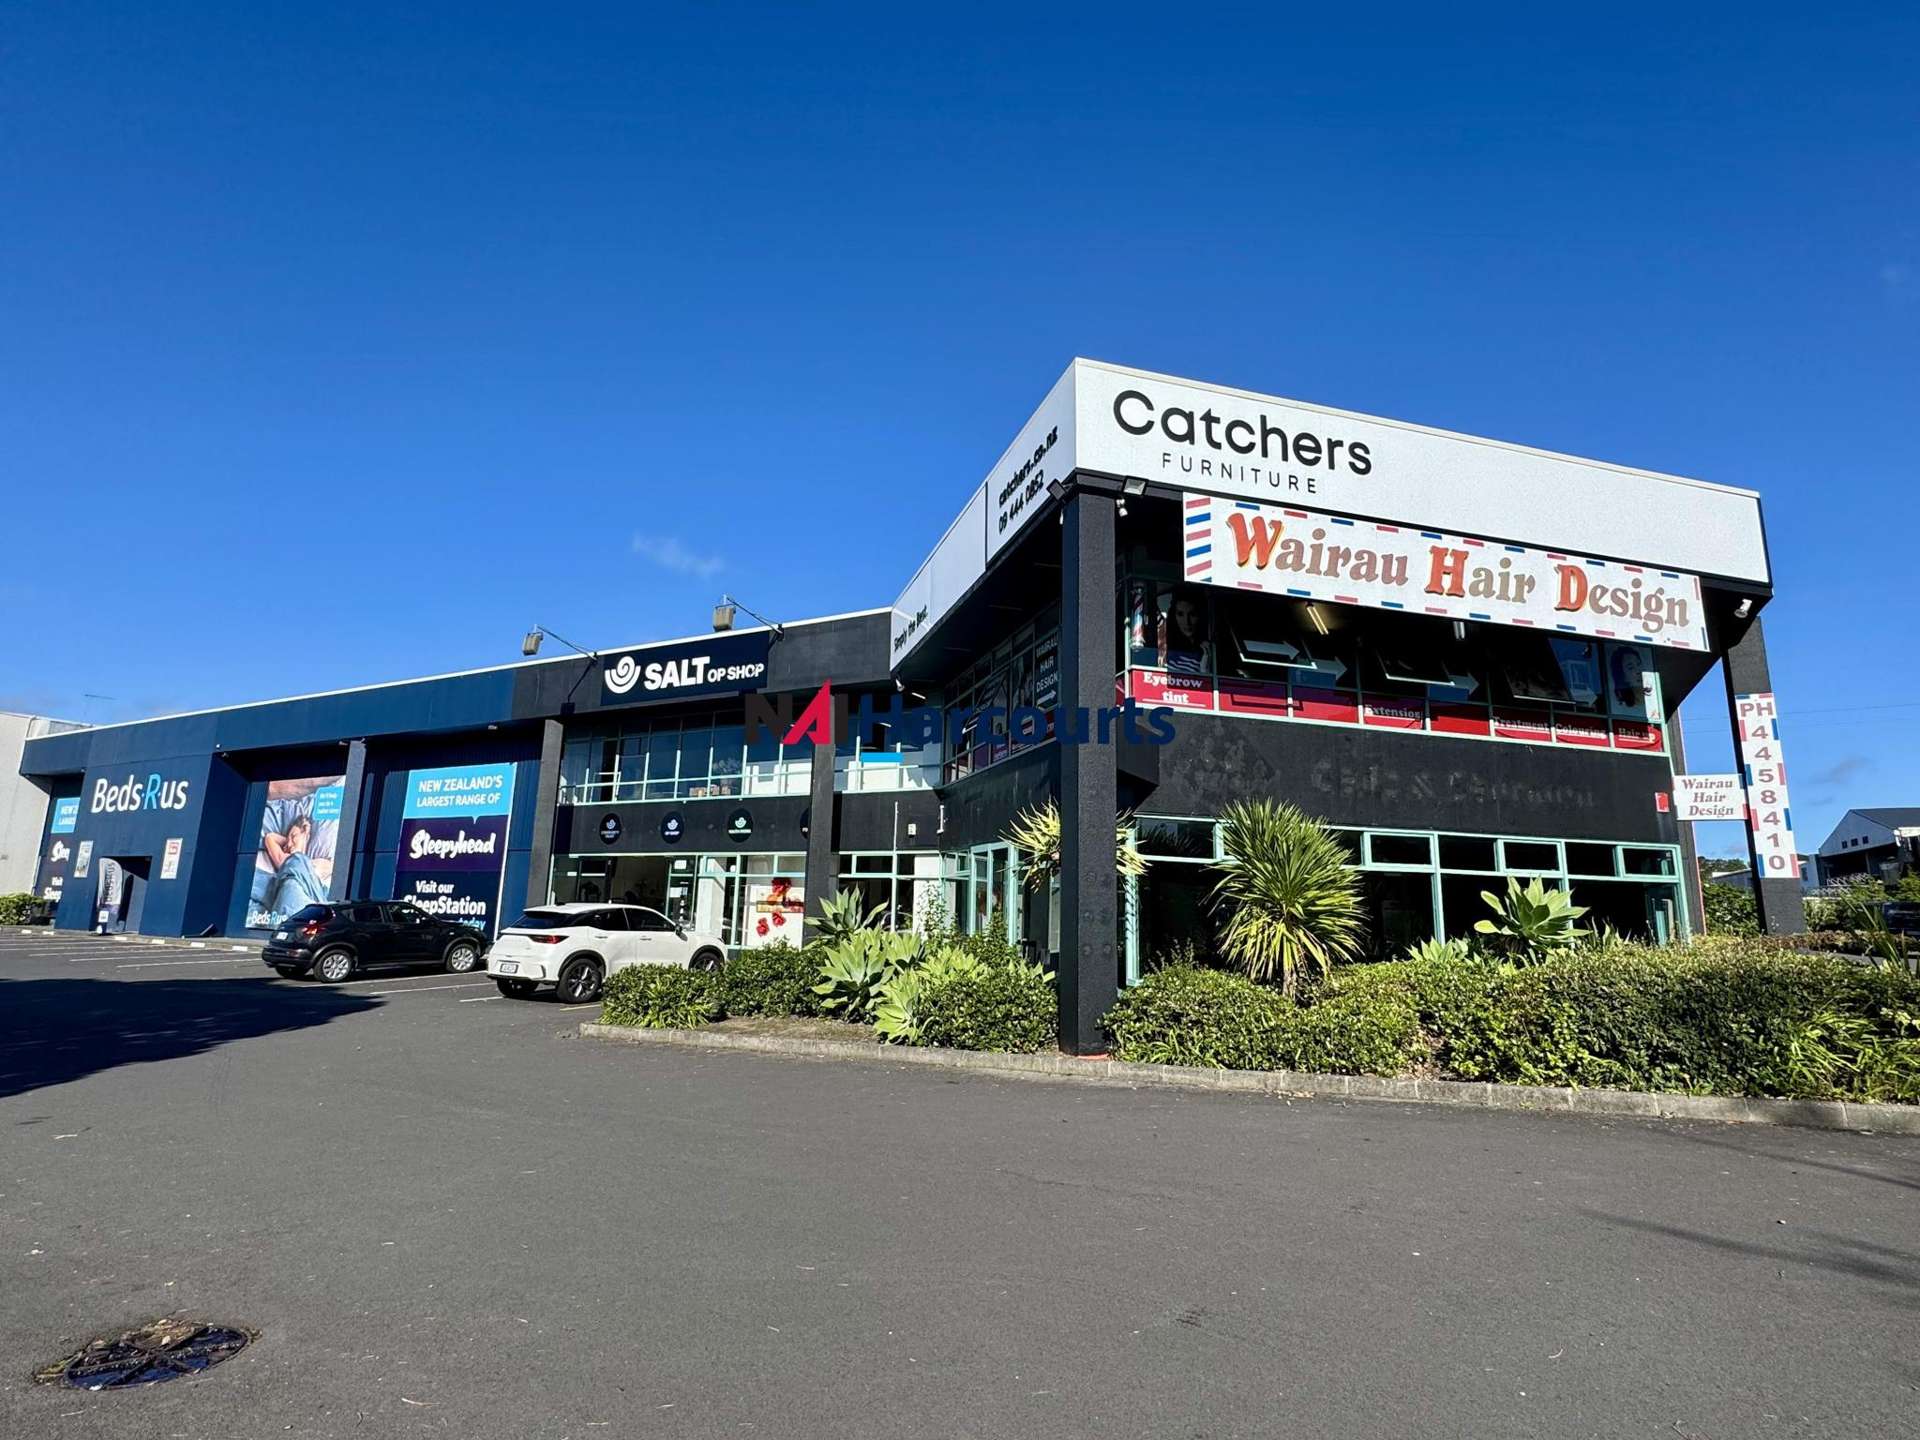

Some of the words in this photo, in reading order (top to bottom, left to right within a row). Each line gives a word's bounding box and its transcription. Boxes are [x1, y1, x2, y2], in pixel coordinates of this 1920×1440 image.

[1113, 389, 1372, 475] Catchers
[1162, 452, 1317, 494] FURNITURE
[1010, 492, 1024, 520] 444
[1226, 512, 1409, 587] Wairau
[1424, 545, 1536, 604] Hair
[1553, 563, 1691, 634] Design
[644, 656, 711, 690] SALT
[707, 668, 726, 683] OP
[727, 663, 765, 682] SHOP
[1143, 672, 1202, 688] Eyebrow
[1036, 672, 1058, 692] DESIGN
[1162, 691, 1189, 703] tint
[1740, 702, 1774, 718] PH
[1493, 716, 1550, 731] Treatment
[1555, 723, 1607, 739] Colouring
[1618, 728, 1640, 738] Hair
[418, 779, 442, 793] NEW
[443, 774, 504, 792] ZEALAND'S
[1682, 778, 1734, 790] Wairau
[416, 795, 455, 808] LARGEST
[456, 793, 486, 806] RANGE
[487, 792, 502, 805] OF
[1693, 792, 1727, 803] Hair
[1688, 805, 1735, 819] Design
[409, 829, 497, 859] Sleepyhead
[416, 880, 437, 894] Visit
[438, 884, 455, 894] our
